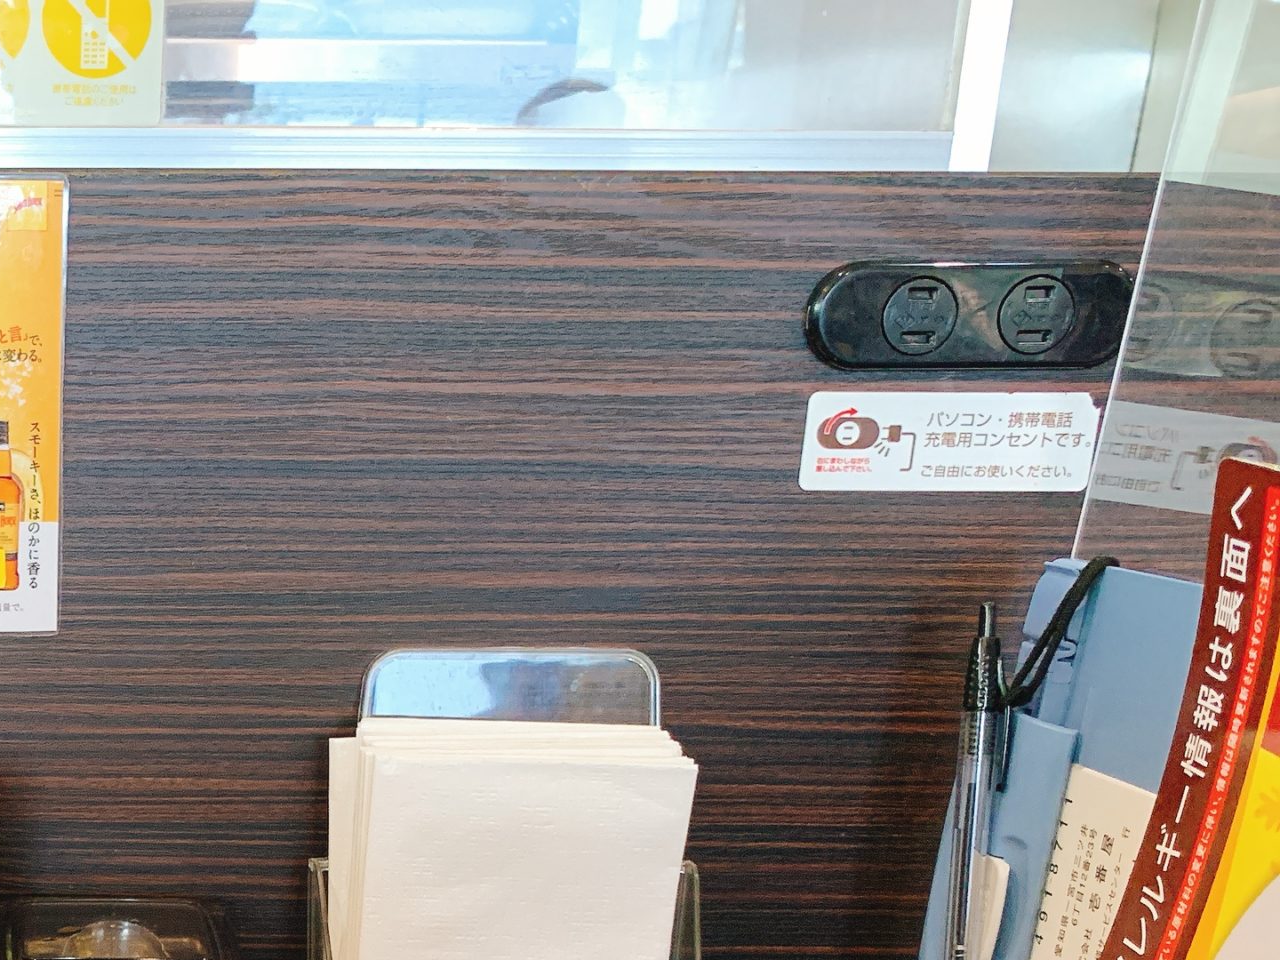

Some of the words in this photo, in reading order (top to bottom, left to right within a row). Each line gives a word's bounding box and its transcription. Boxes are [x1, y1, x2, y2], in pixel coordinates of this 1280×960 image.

[926, 411, 1073, 429] パソコン・携帯電話
[923, 430, 1092, 449] 充電用コンセントです。
[920, 464, 1073, 479] ご自由にお使いください。
[27, 421, 42, 590] スモーキーさ、ほのかに香る
